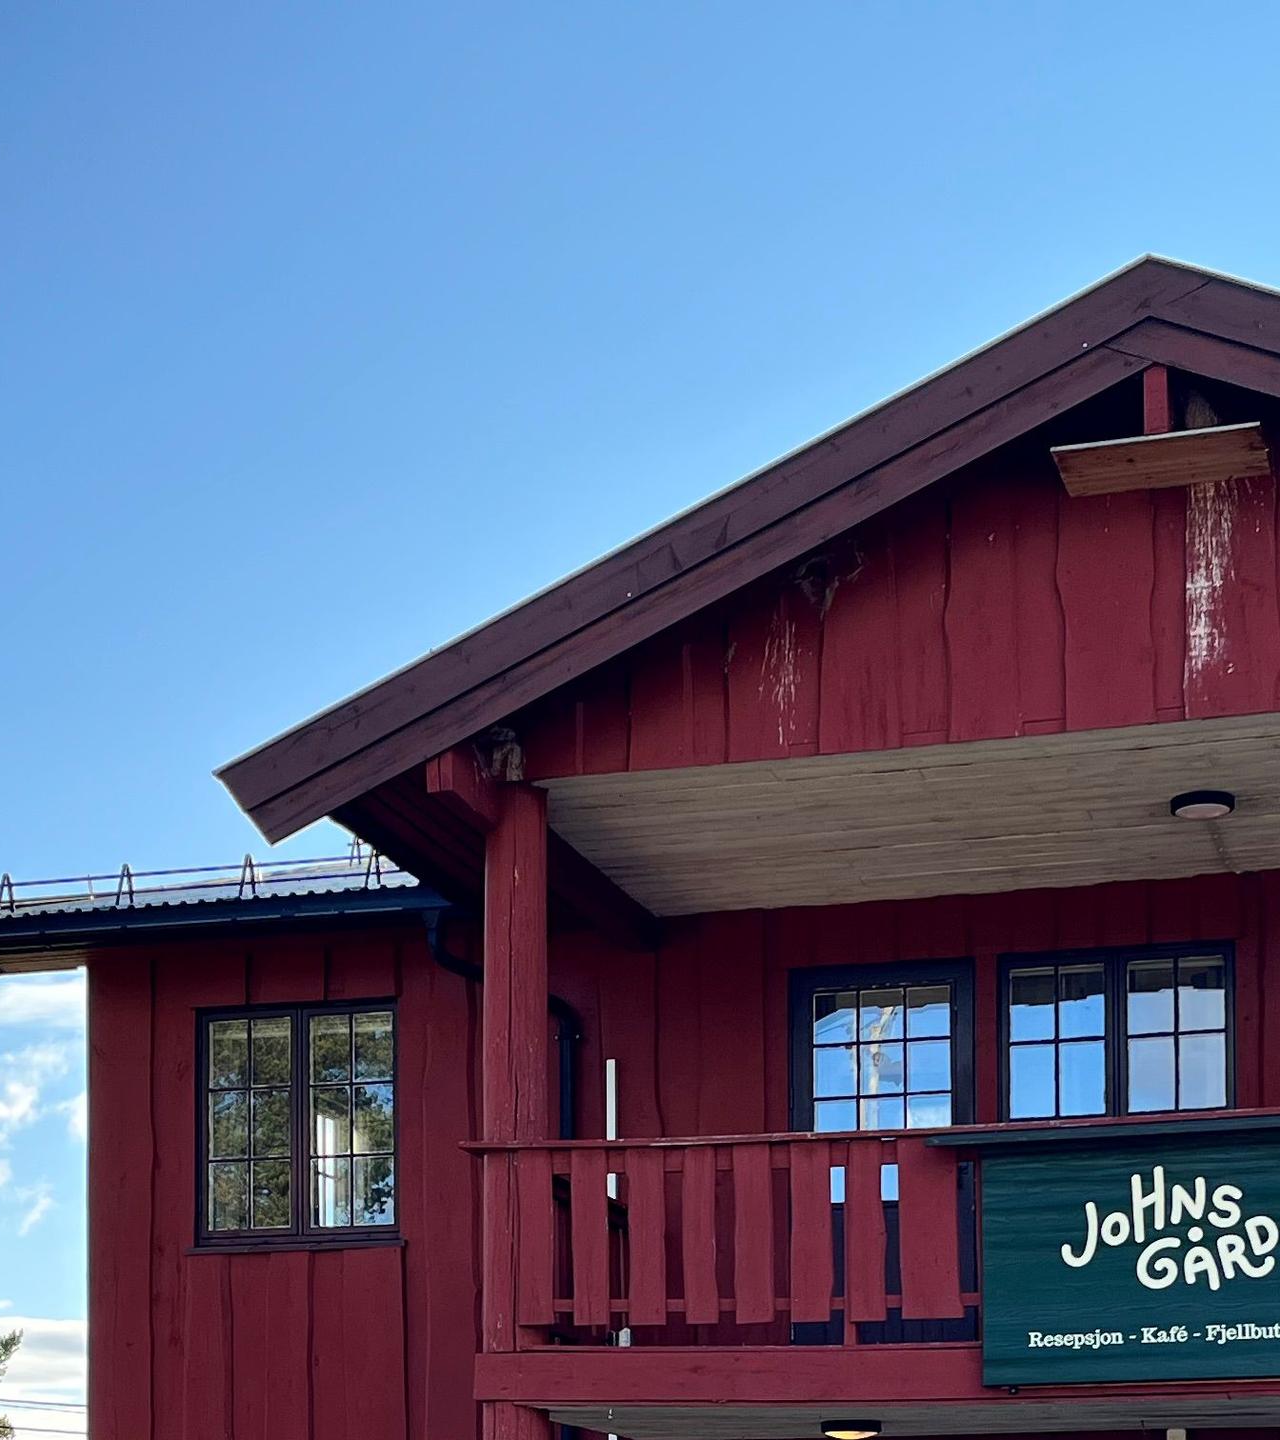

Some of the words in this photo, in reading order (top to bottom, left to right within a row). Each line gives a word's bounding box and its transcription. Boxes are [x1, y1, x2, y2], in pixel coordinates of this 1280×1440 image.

[1136, 1215, 1280, 1292] GÅRD
[1028, 1328, 1124, 1350] Resepsjon
[1141, 1325, 1188, 1343] Kafé
